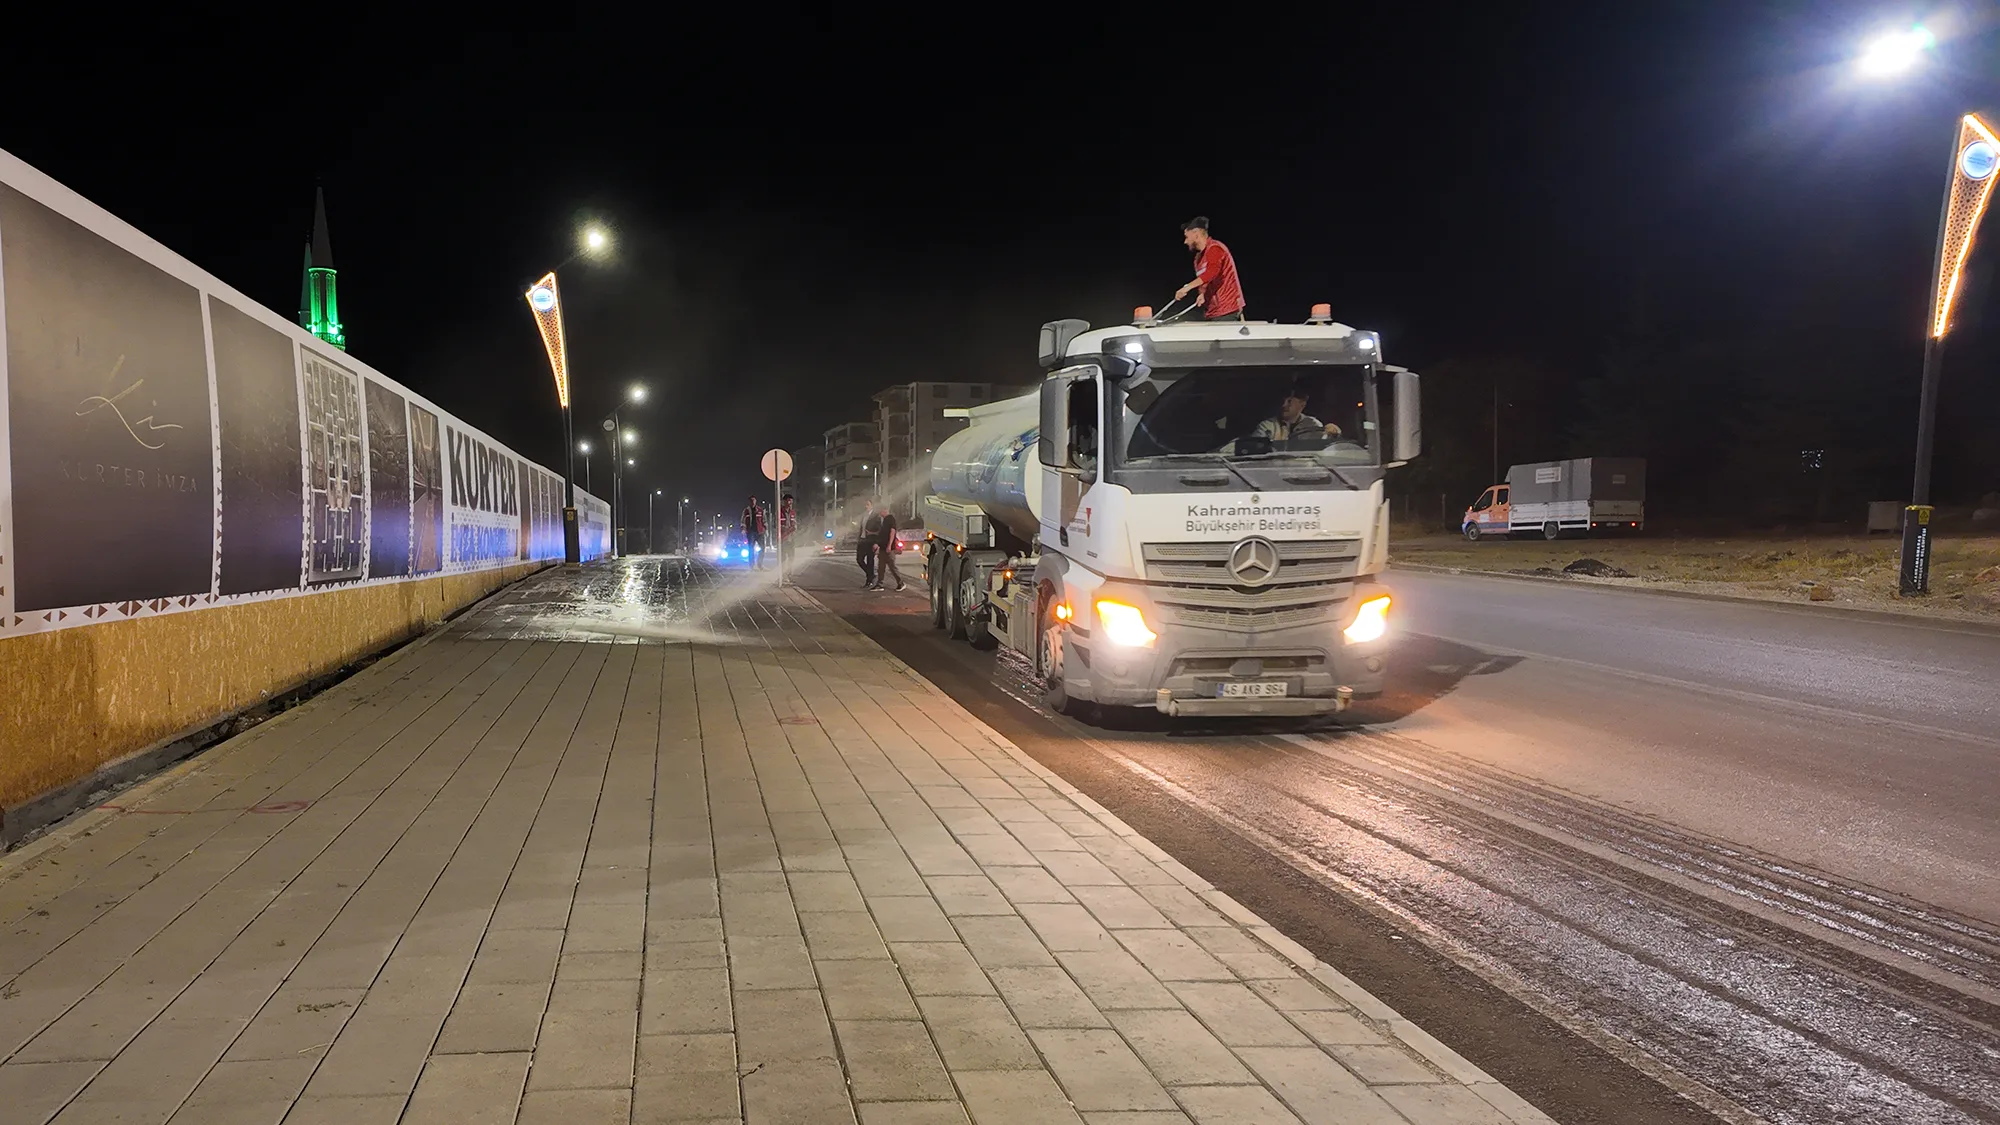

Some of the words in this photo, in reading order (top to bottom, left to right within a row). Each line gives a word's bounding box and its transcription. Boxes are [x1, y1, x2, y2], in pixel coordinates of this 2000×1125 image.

[60, 458, 146, 488] KURTER
[446, 425, 518, 517] KURTER
[1187, 504, 1321, 518] Kahramanmaraş
[1186, 519, 1256, 535] Büyükşehir
[1259, 517, 1321, 532] Belediyesi
